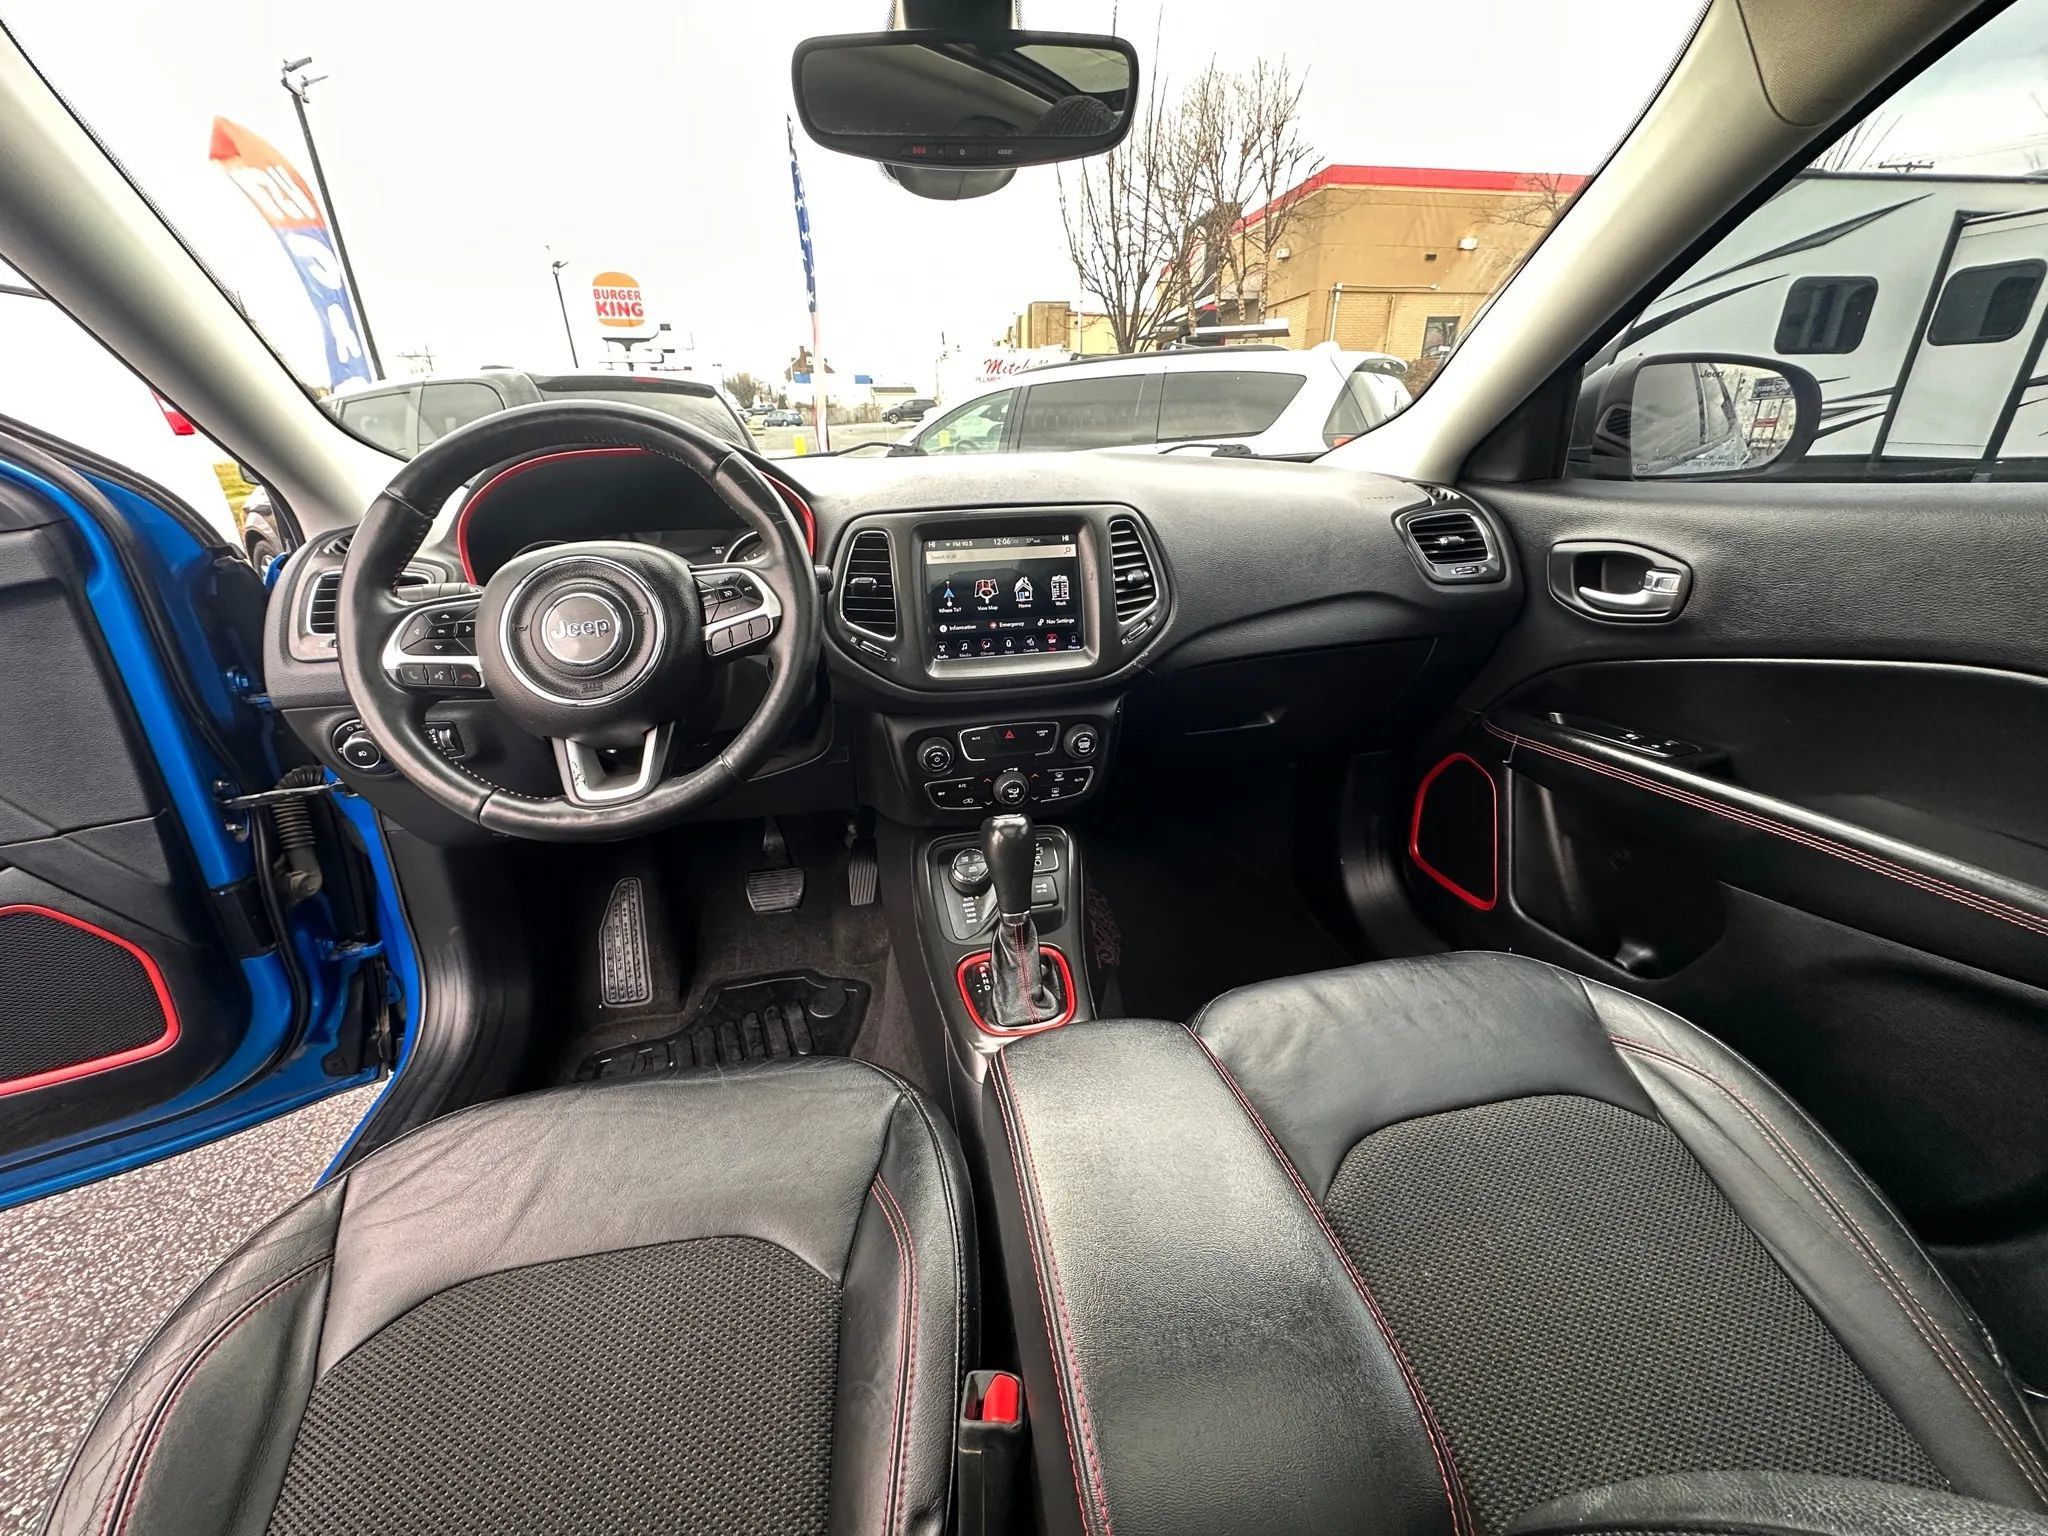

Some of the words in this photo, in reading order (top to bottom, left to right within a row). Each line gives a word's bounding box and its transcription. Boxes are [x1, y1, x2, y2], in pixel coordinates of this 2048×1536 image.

[593, 288, 642, 301] BURGER
[595, 301, 644, 318] KING
[1699, 369, 1725, 378] Jeep
[551, 619, 611, 640] Jeep
